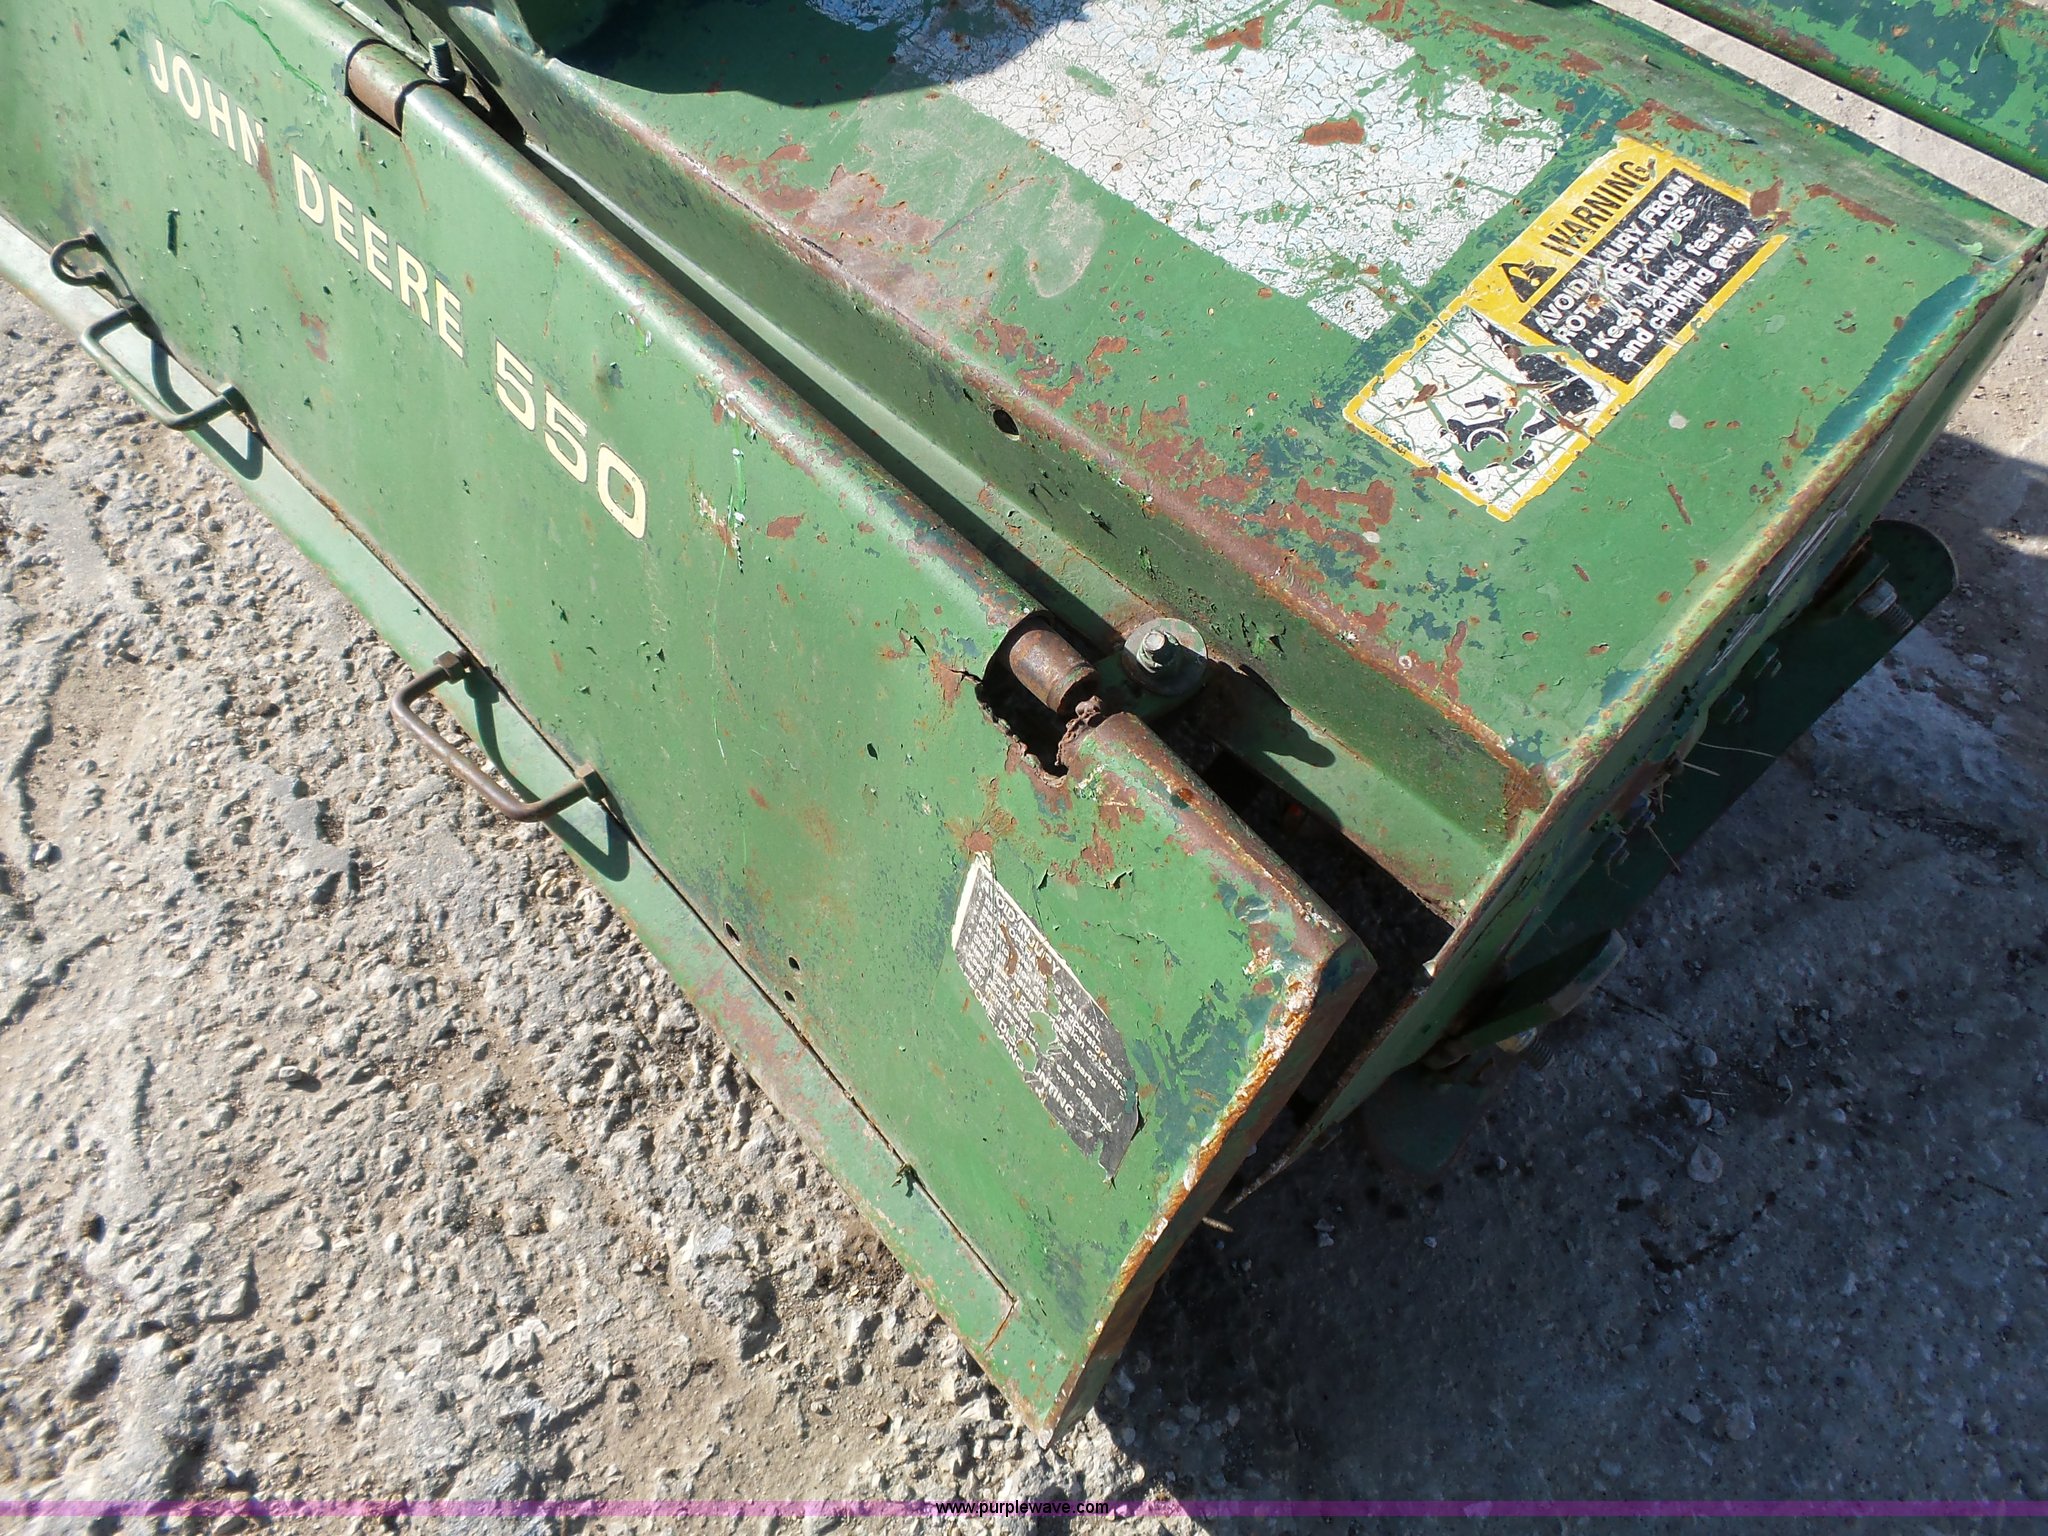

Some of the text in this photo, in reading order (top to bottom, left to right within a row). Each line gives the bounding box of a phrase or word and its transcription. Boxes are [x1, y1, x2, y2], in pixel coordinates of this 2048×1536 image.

[1540, 158, 1652, 258] WARNING
[1631, 204, 1696, 263] KNIVES
[149, 39, 648, 539] JOHN DEERE 550
[1531, 276, 1591, 331] AVOID
[1638, 175, 1692, 225] FROM
[1592, 306, 1646, 350] Keep
[1685, 221, 1723, 256] feet
[1617, 226, 1755, 362] and clothing away
[1062, 991, 1102, 1043] MANUAL
[1066, 1011, 1112, 1069] operator's
[1055, 1061, 1076, 1089] safe
[1072, 1057, 1097, 1090] parts
